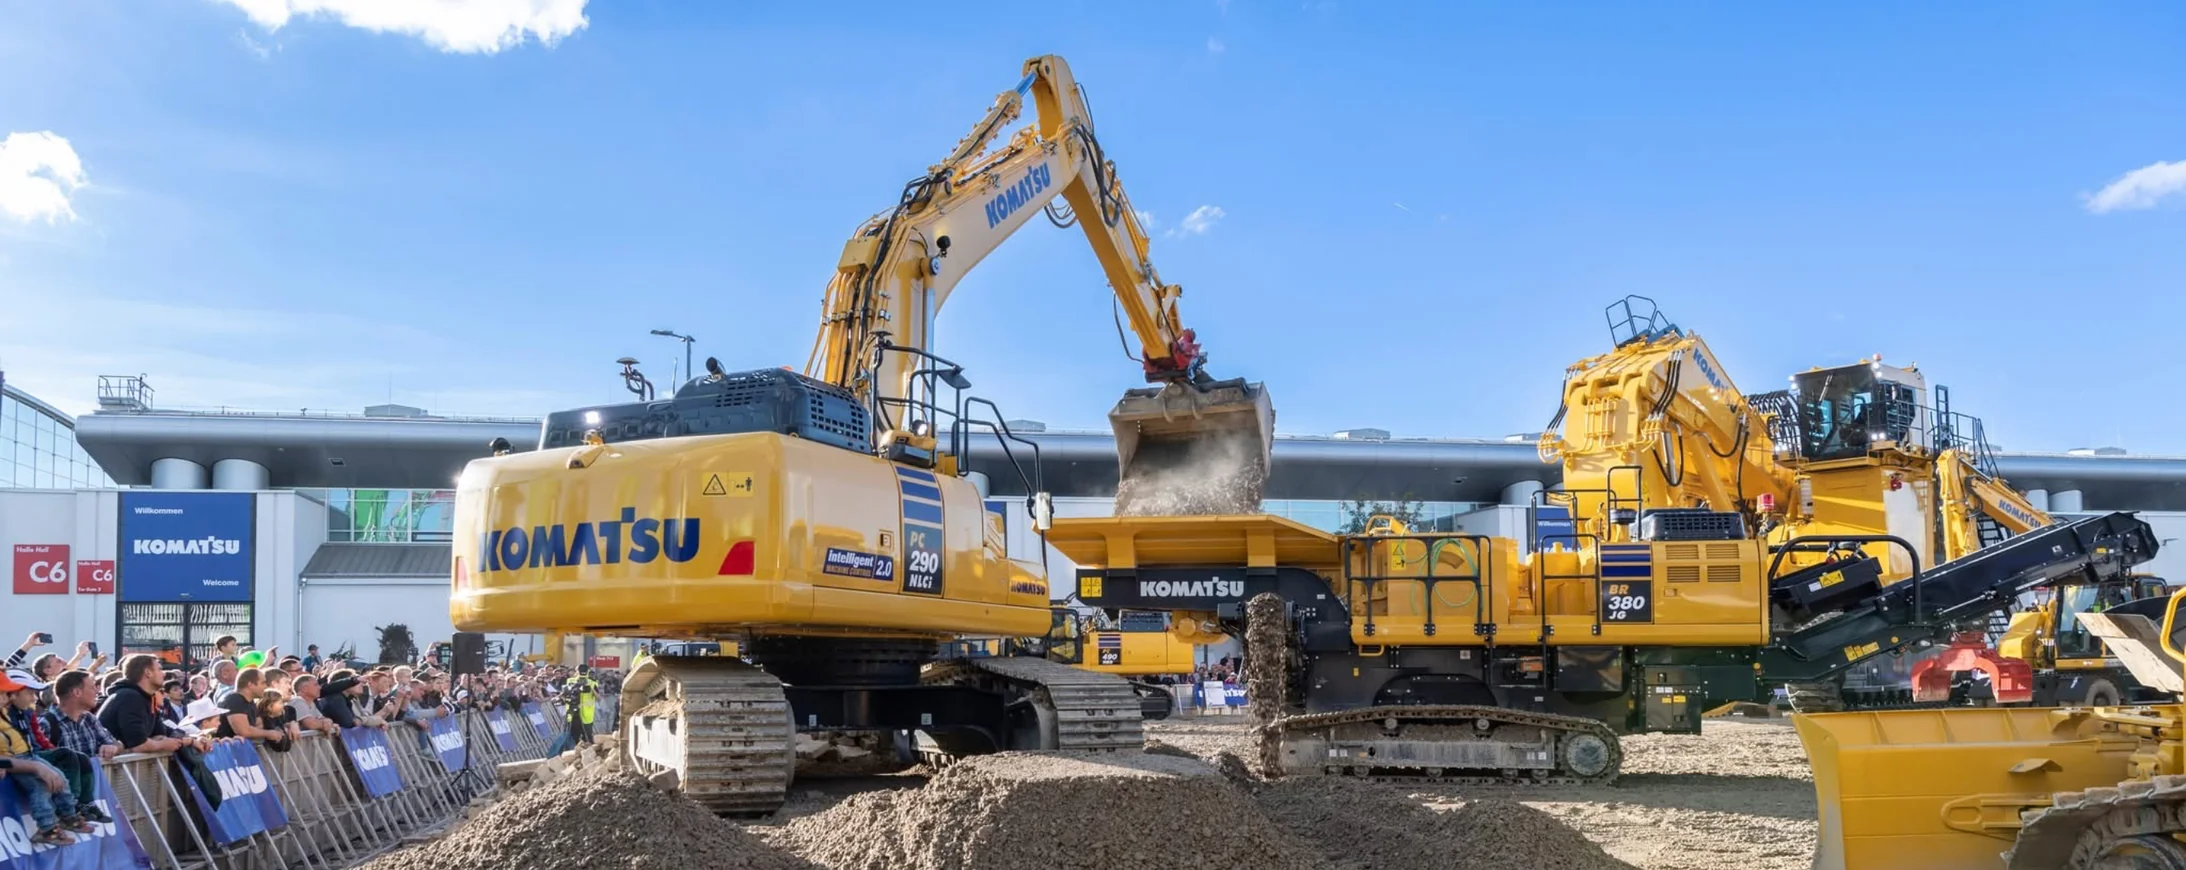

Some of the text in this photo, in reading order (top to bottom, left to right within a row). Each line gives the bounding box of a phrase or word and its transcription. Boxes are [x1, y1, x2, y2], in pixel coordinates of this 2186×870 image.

[985, 162, 1051, 229] KOMATSU
[1999, 500, 2041, 528] KOMATSU
[133, 536, 240, 555] KOMATSU
[478, 507, 700, 572] KOMATSU
[910, 531, 926, 548] PC
[828, 550, 893, 577] intelligent 2.0
[909, 550, 939, 574] 290
[29, 561, 66, 583] C6
[92, 569, 113, 581] C6
[909, 574, 932, 589] NLCi
[1140, 576, 1244, 597] KOMATSU
[1609, 584, 1630, 595] BR
[1608, 596, 1645, 610] 380
[1608, 610, 1627, 619] JG
[1102, 653, 1118, 661] 490
